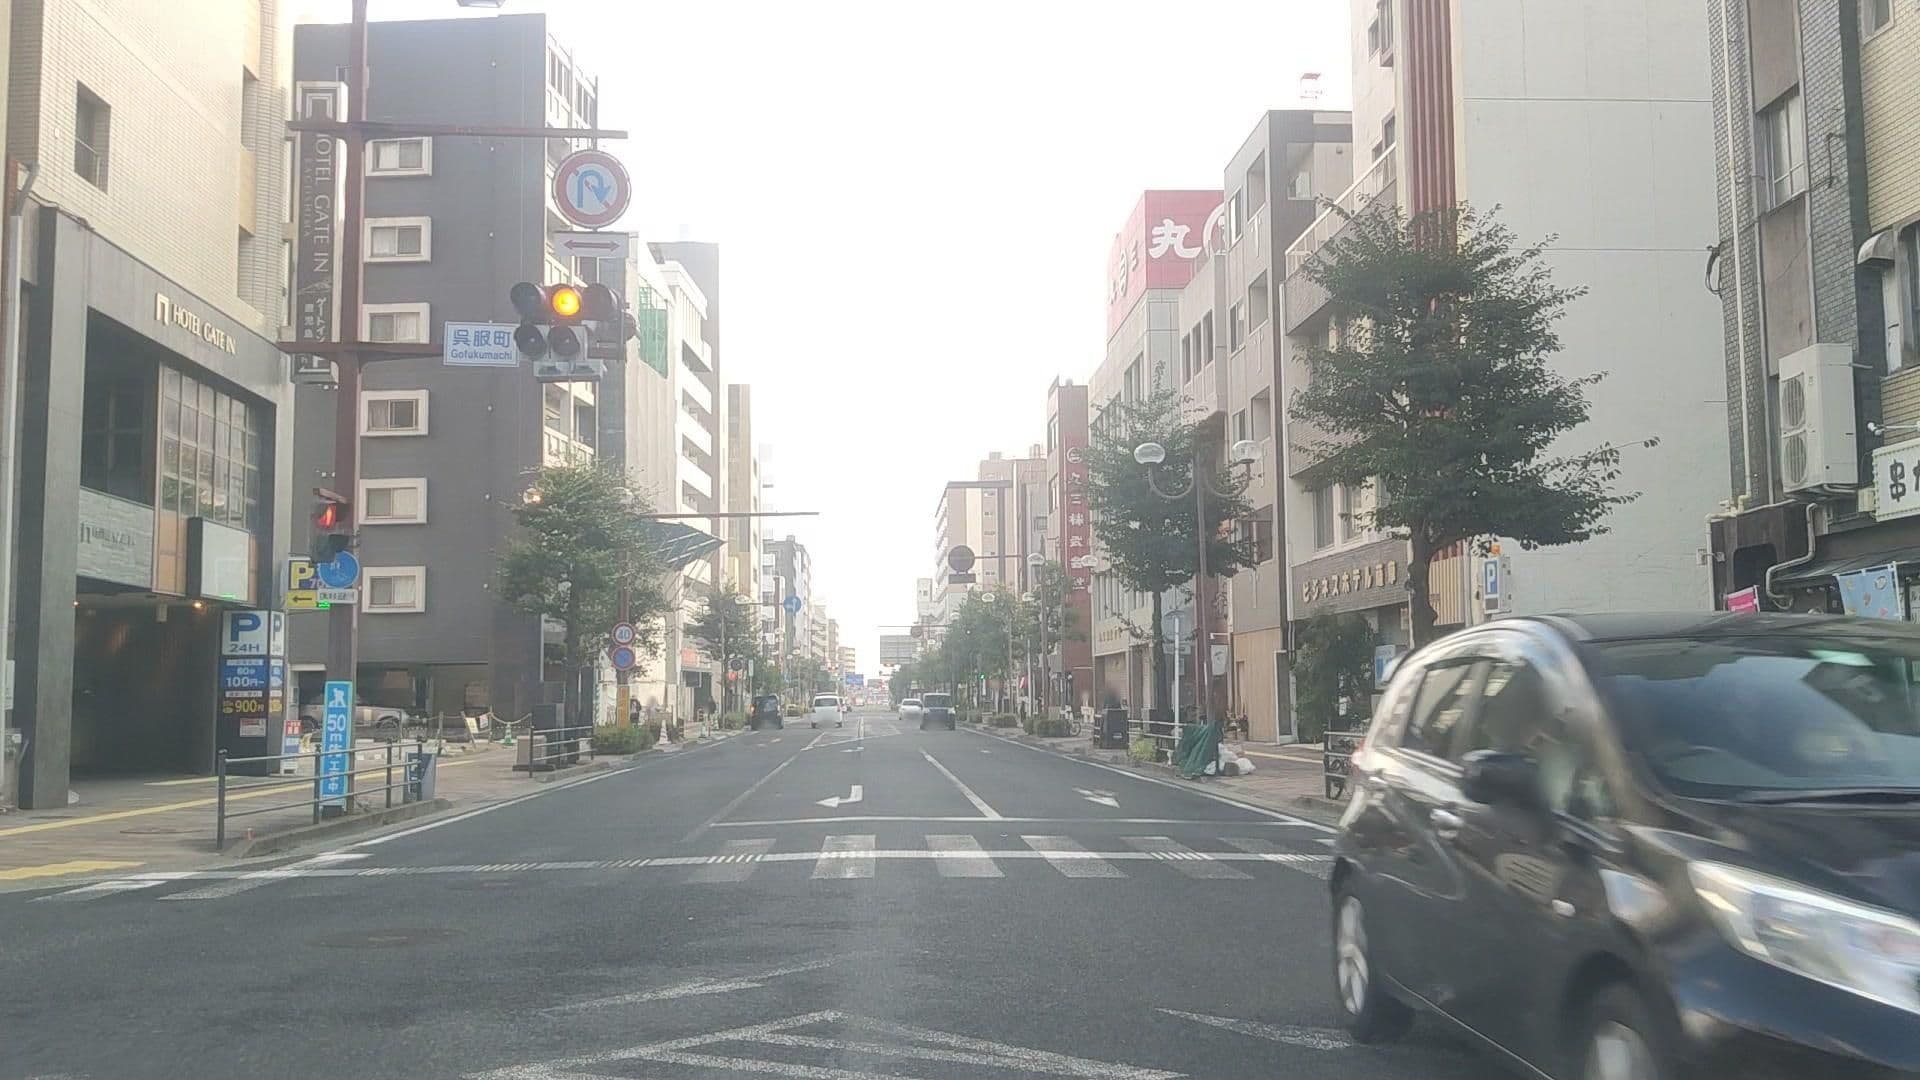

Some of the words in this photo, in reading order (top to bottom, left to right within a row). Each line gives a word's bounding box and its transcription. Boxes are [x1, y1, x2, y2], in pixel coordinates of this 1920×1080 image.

[313, 194, 330, 245] GATE
[1148, 217, 1203, 259] 丸
[313, 252, 329, 272] IN
[172, 303, 201, 336] HOTEL
[203, 321, 225, 351] GATE
[225, 335, 237, 355] IN
[452, 329, 512, 348] 呉服町
[450, 348, 513, 360] Gofukumachi
[1889, 458, 1920, 503] 串
[290, 561, 315, 590] P
[1486, 563, 1497, 594] P
[230, 613, 262, 642] P
[617, 628, 631, 641] 40
[229, 643, 260, 653] 24H
